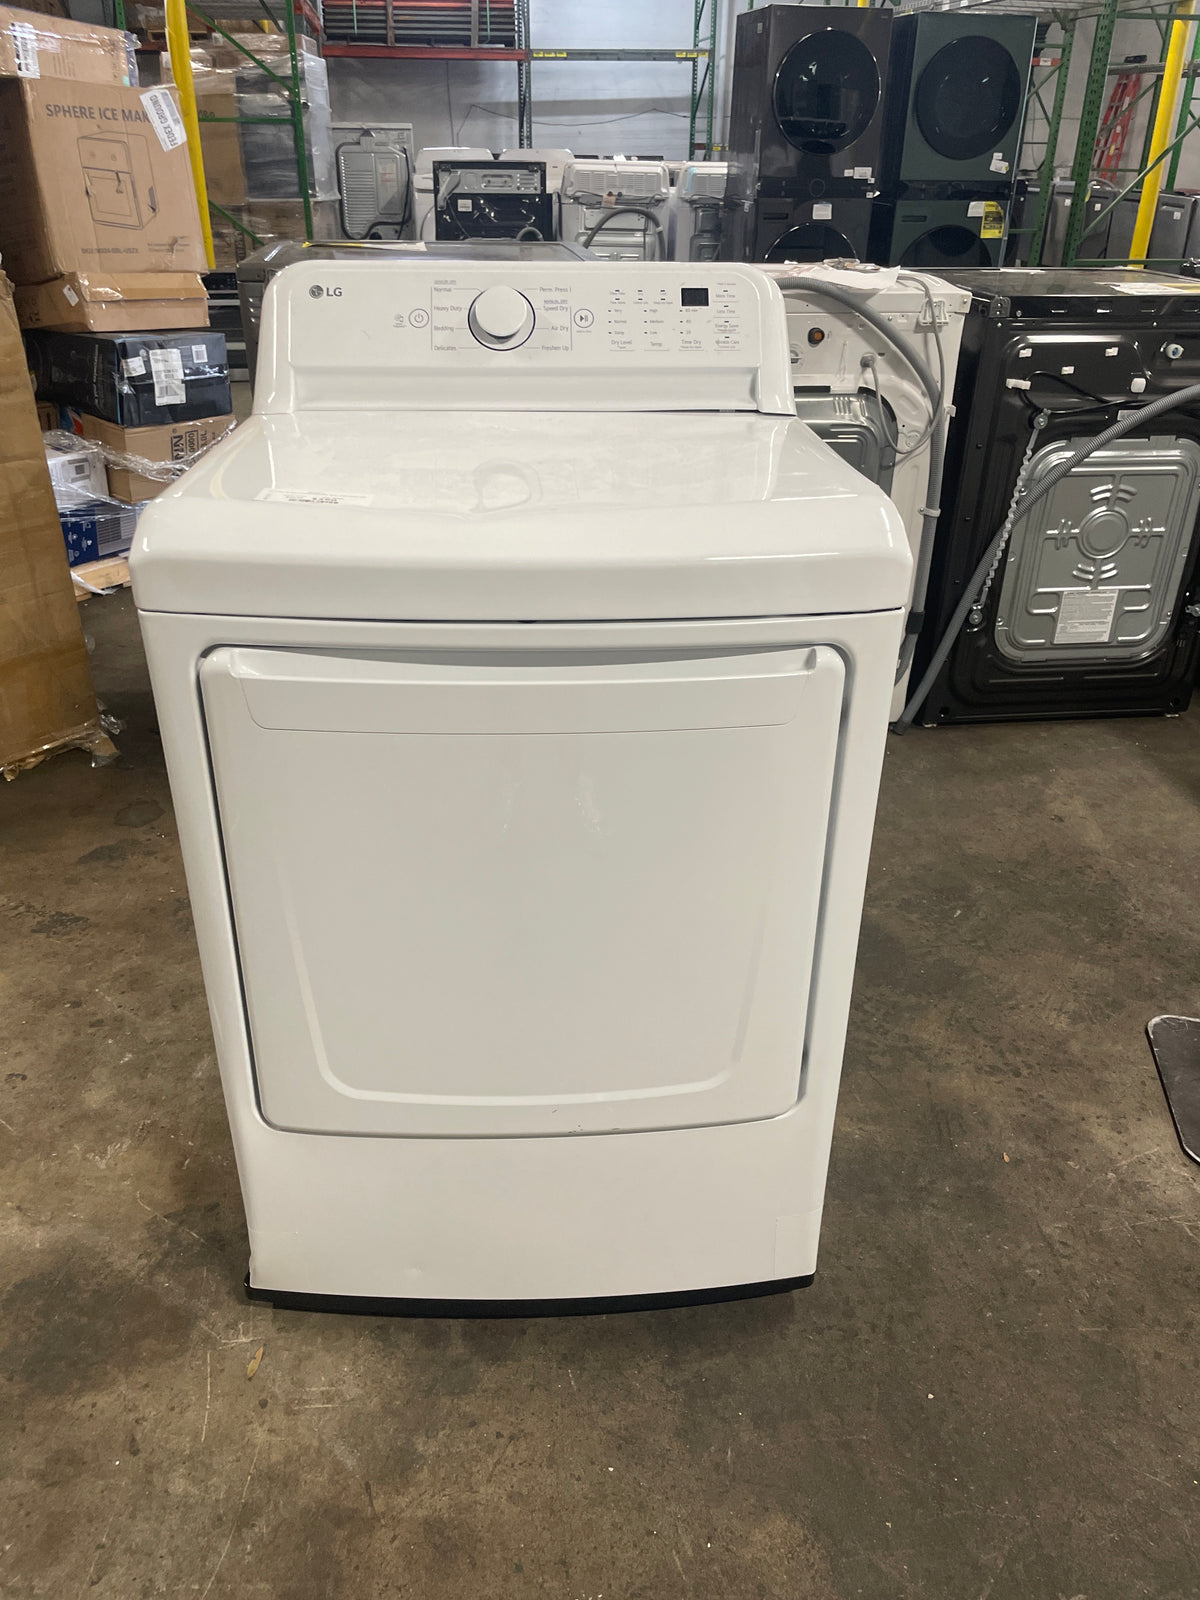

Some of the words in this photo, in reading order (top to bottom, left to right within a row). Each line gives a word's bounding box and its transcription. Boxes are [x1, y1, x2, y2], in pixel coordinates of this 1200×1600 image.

[45, 103, 96, 119] SPHERE
[98, 107, 119, 121] ICE
[149, 94, 168, 124] GROUND
[163, 124, 179, 147] FEDEX
[326, 287, 343, 297] LG
